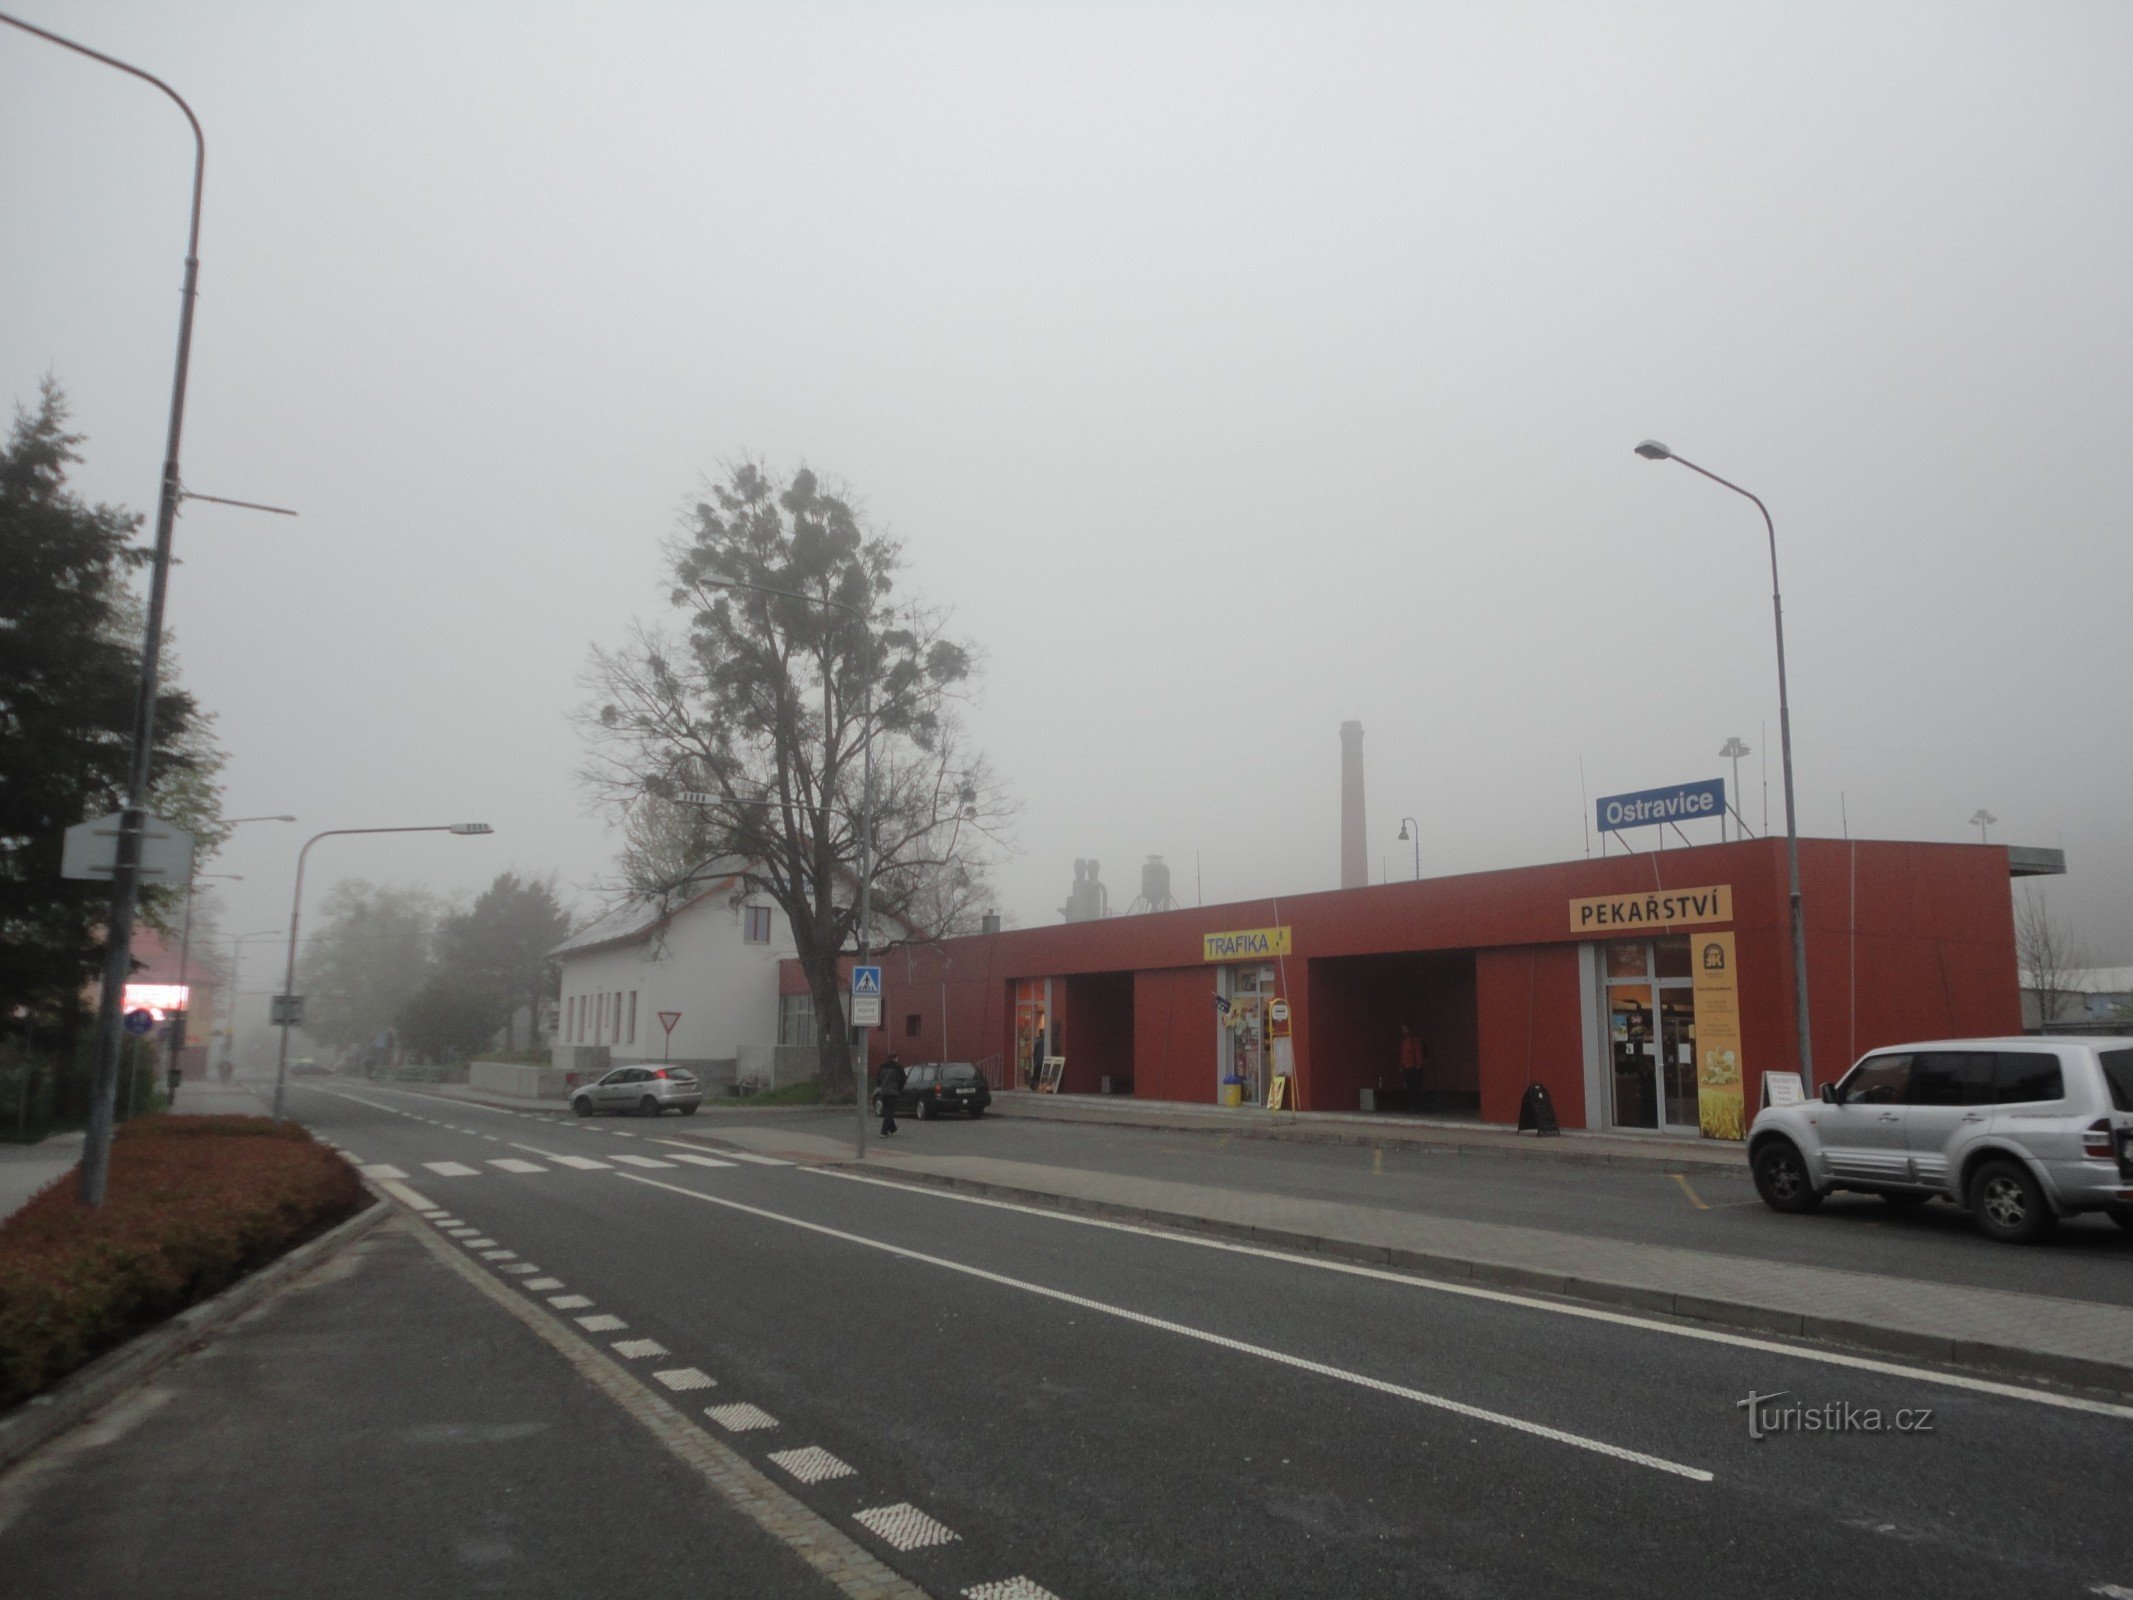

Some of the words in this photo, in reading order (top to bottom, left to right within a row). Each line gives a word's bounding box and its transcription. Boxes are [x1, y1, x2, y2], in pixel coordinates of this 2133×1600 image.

[1606, 791, 1714, 825] Ostravice
[1581, 889, 1718, 926] PEKAŘSTVÍ
[1206, 933, 1269, 956] TRAFIKA
